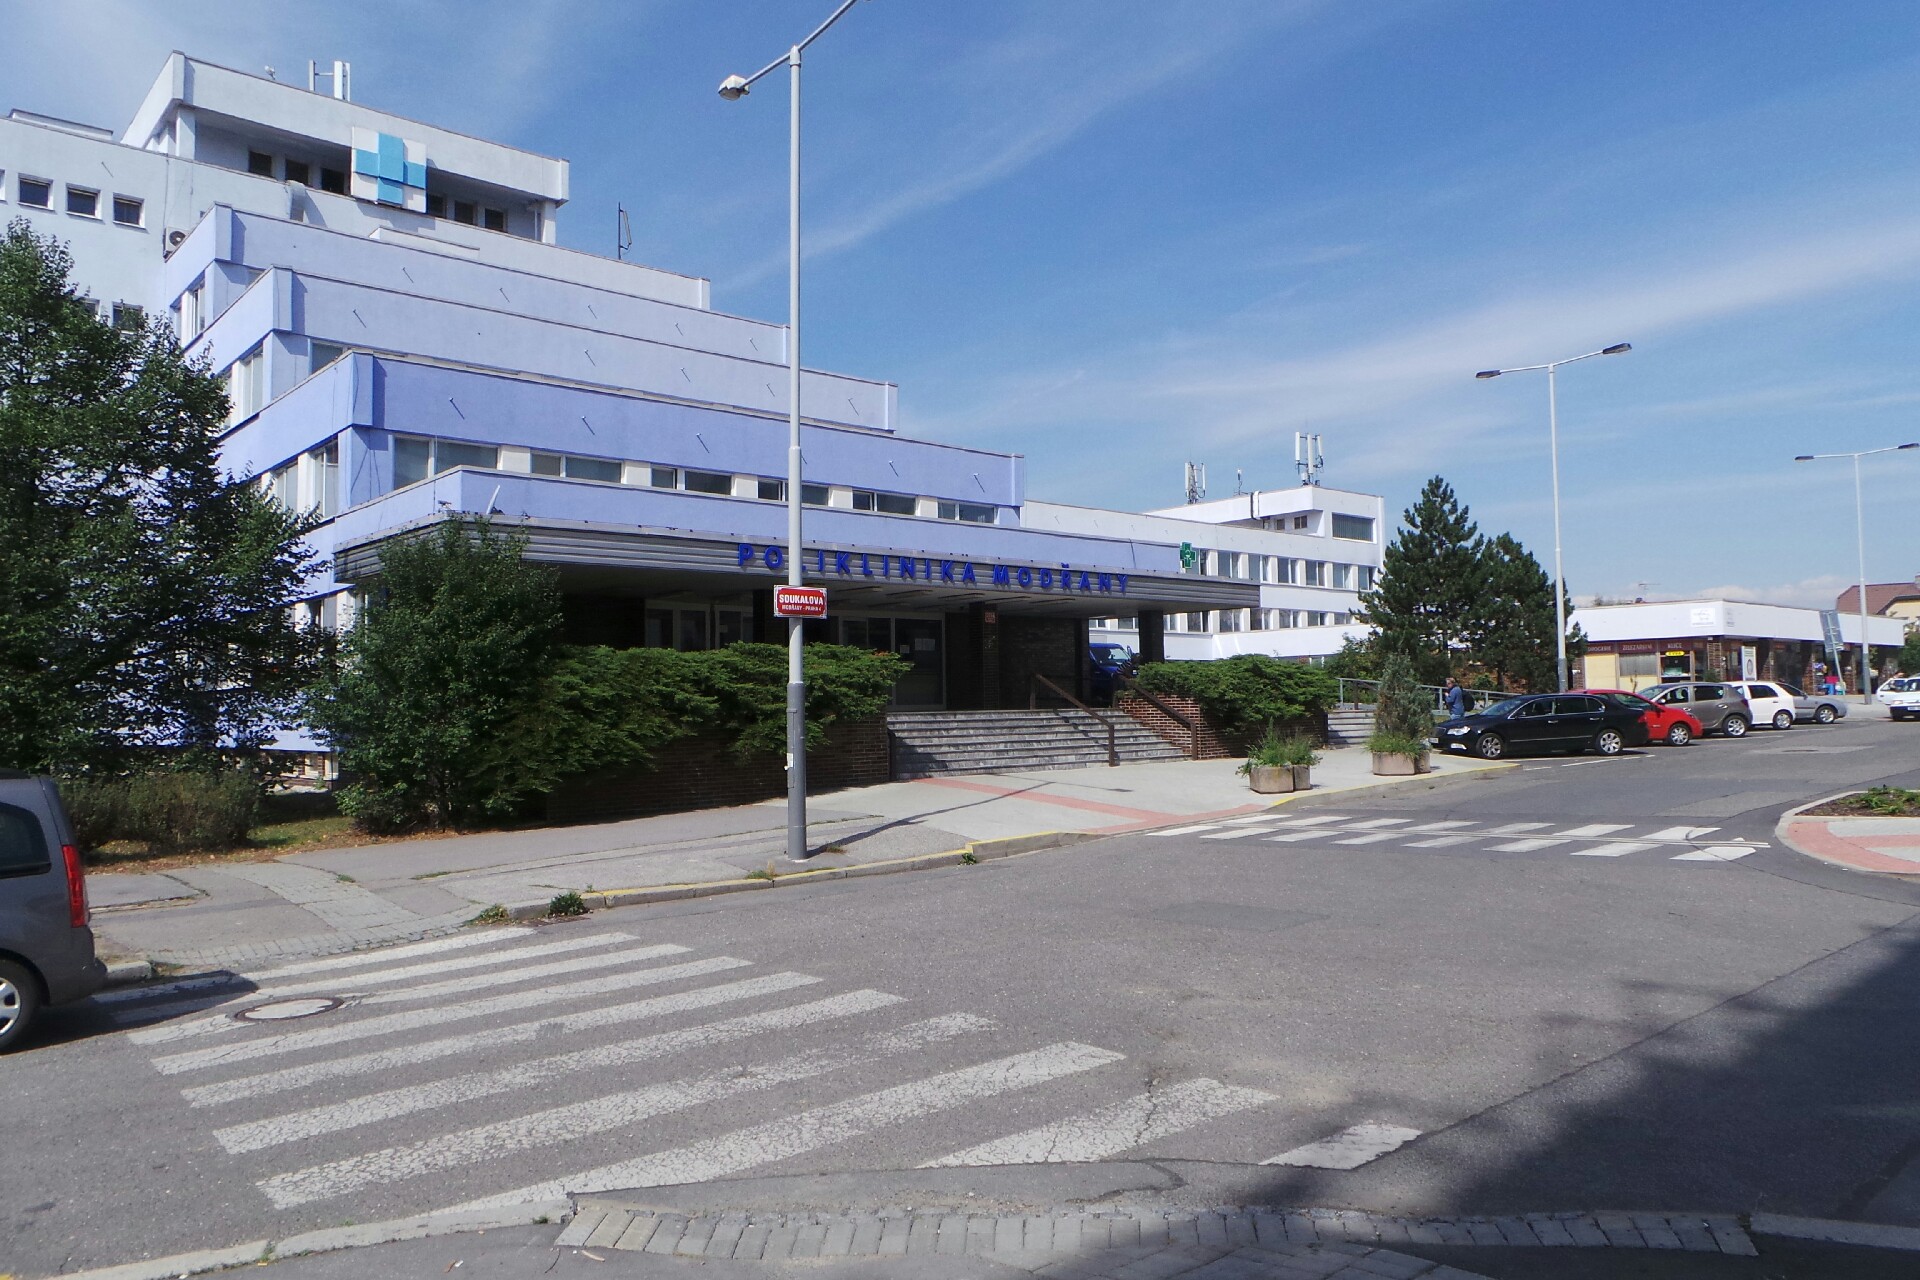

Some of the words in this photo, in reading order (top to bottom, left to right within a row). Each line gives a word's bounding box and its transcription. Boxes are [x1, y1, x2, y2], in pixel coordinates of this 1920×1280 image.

[738, 543, 976, 582] POIKLINIKA
[993, 563, 1128, 593] MODŘANY
[779, 594, 824, 605] SOUKALOVA
